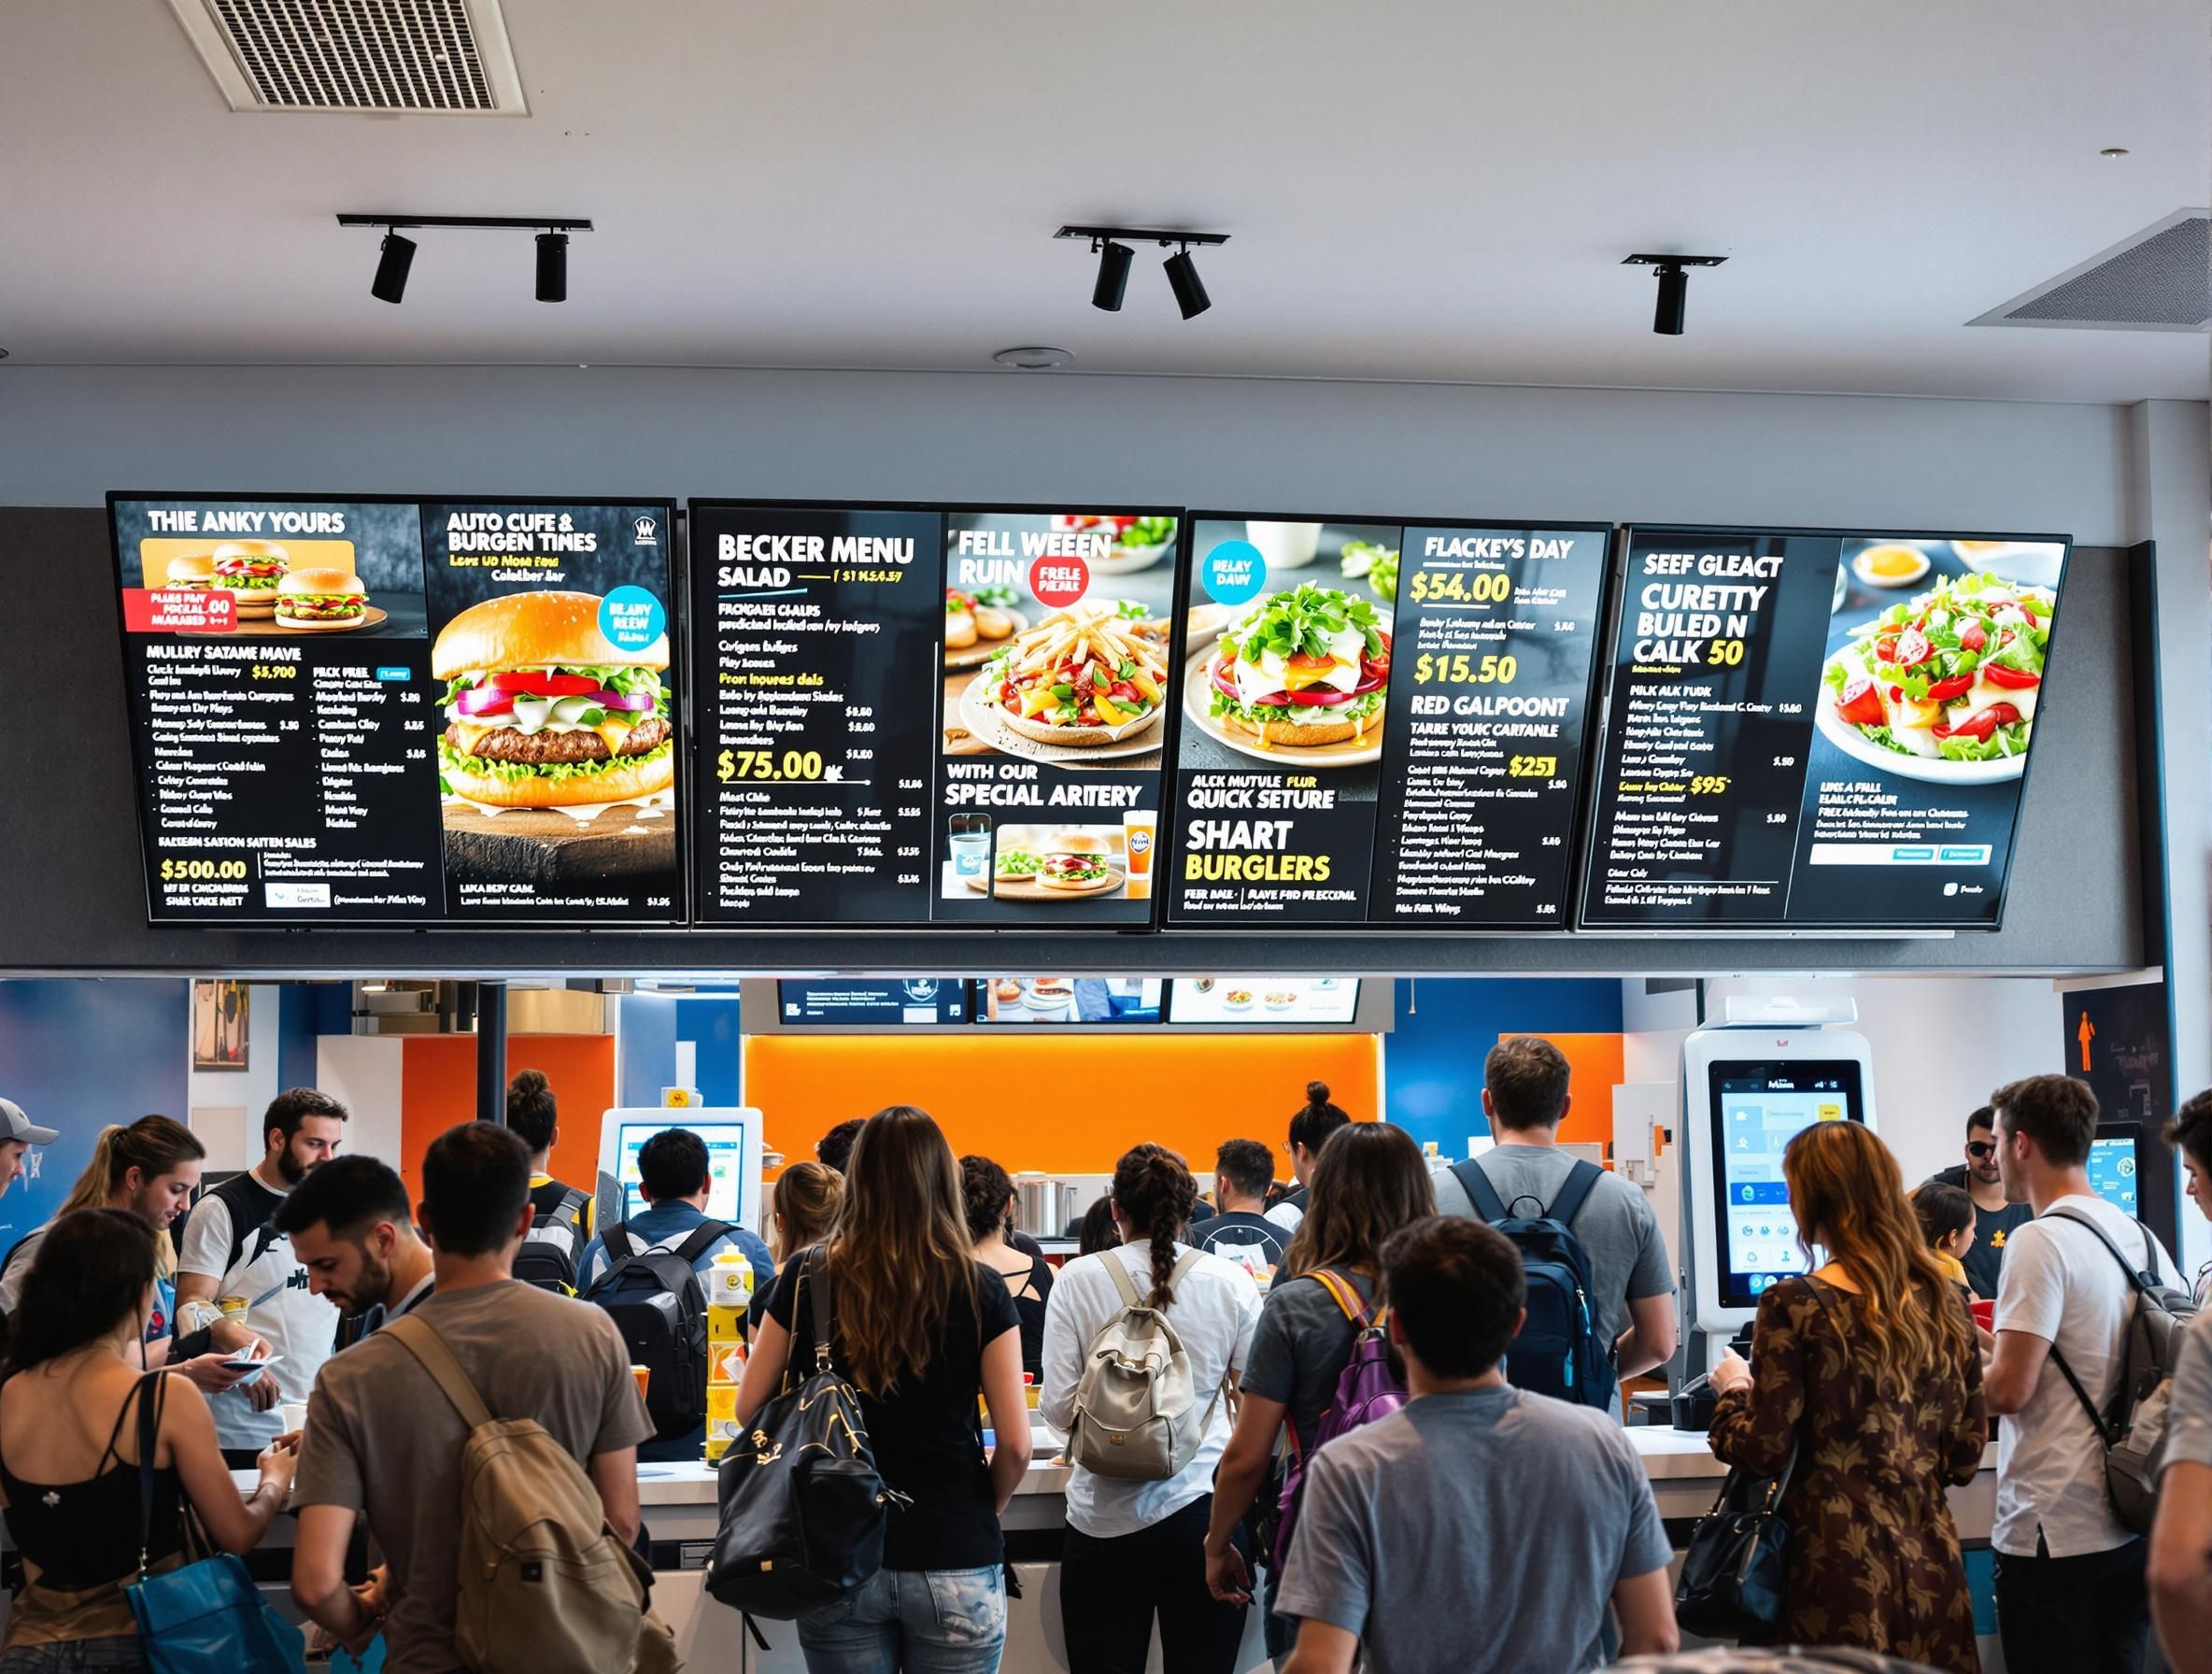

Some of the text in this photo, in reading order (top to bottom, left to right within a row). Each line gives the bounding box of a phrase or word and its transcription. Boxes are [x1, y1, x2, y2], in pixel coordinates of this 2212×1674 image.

[148, 510, 346, 533] THIE ANKY YOURS
[447, 513, 574, 532] AUTO CUFE &
[448, 532, 533, 552] BURGEN
[717, 533, 915, 564] BECKER MENU
[958, 530, 1015, 557] FELL
[1529, 538, 1575, 560] DAY
[717, 566, 791, 588] SALAD
[958, 559, 1025, 584] RUIN
[1643, 553, 1784, 577] SEEF GLEACT
[1410, 571, 1510, 603] $54.00
[1641, 583, 1769, 611] CURETTY
[1637, 612, 1749, 638] BULED N
[1634, 640, 1744, 665] CALK 50
[1413, 653, 1518, 685] $15.50
[1411, 695, 1450, 715] RED
[716, 749, 822, 781] $75.00
[946, 763, 1038, 780] WITH OUR
[944, 783, 1044, 806] SPECIAL
[1187, 789, 1335, 809] QUICK SETURE
[1185, 819, 1294, 850] SHART
[160, 858, 247, 881] $500.00
[1184, 854, 1331, 882] BURGLERS
